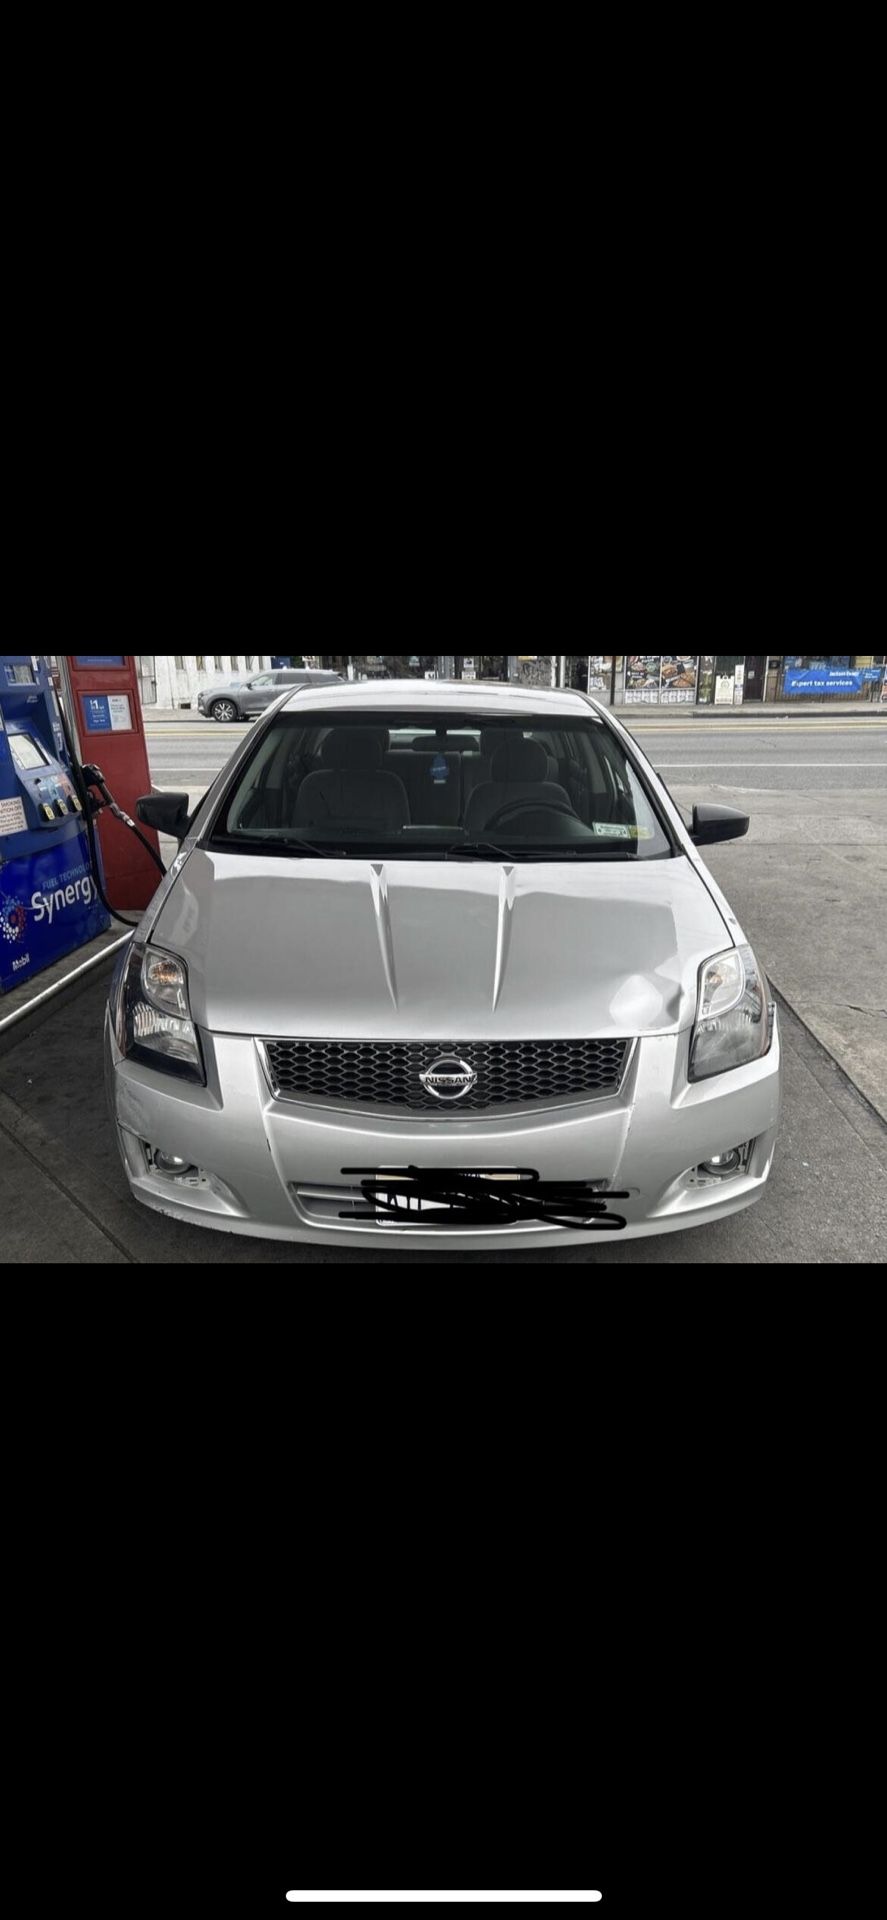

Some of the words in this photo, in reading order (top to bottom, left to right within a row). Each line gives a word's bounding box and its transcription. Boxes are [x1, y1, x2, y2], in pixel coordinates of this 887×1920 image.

[42, 877, 58, 890] FUEL
[12, 953, 30, 971] Mobil
[425, 1076, 470, 1084] NISSAN
